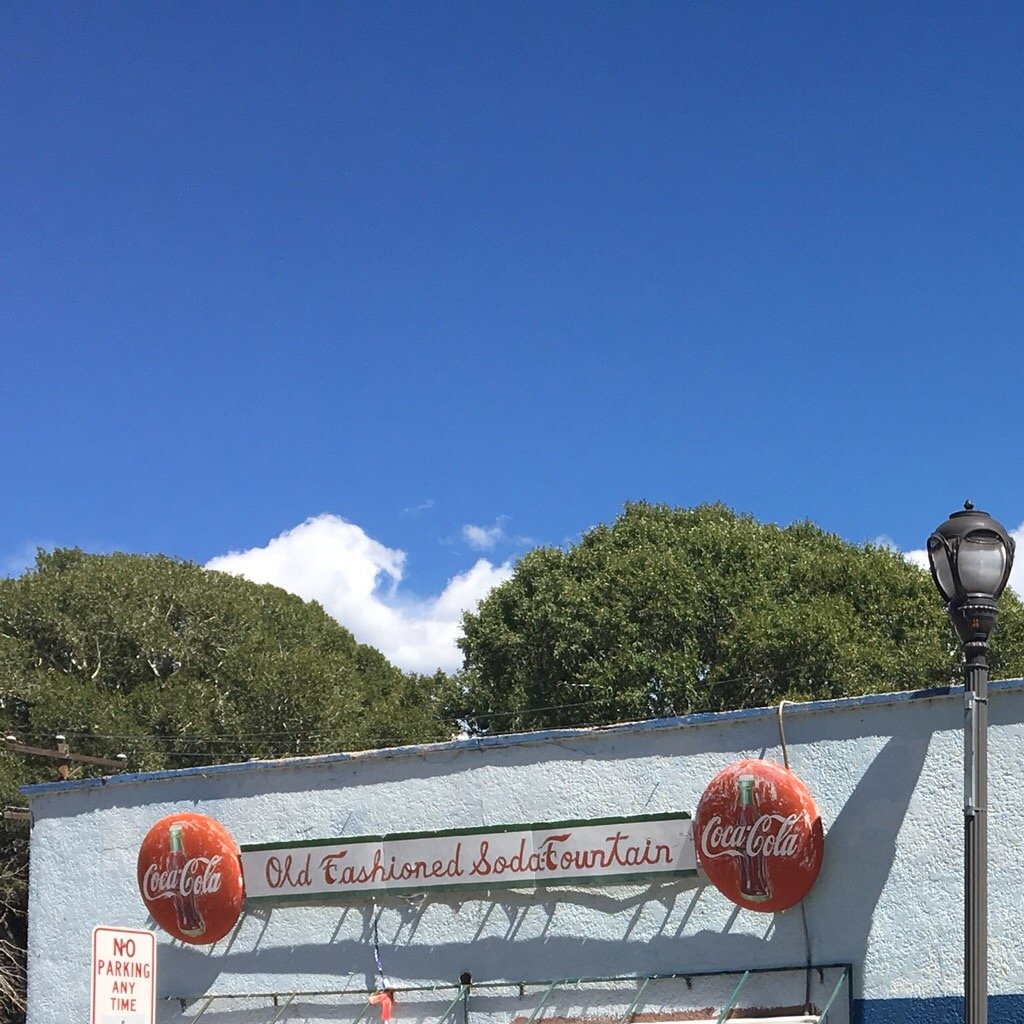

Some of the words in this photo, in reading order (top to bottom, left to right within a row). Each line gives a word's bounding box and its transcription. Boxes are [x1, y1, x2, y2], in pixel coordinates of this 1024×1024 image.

[265, 853, 312, 889] Old
[319, 842, 464, 886] Fashioned
[113, 938, 136, 958] NO
[98, 960, 150, 978] PARKING
[112, 981, 136, 994] ANY
[110, 998, 137, 1011] TIME
